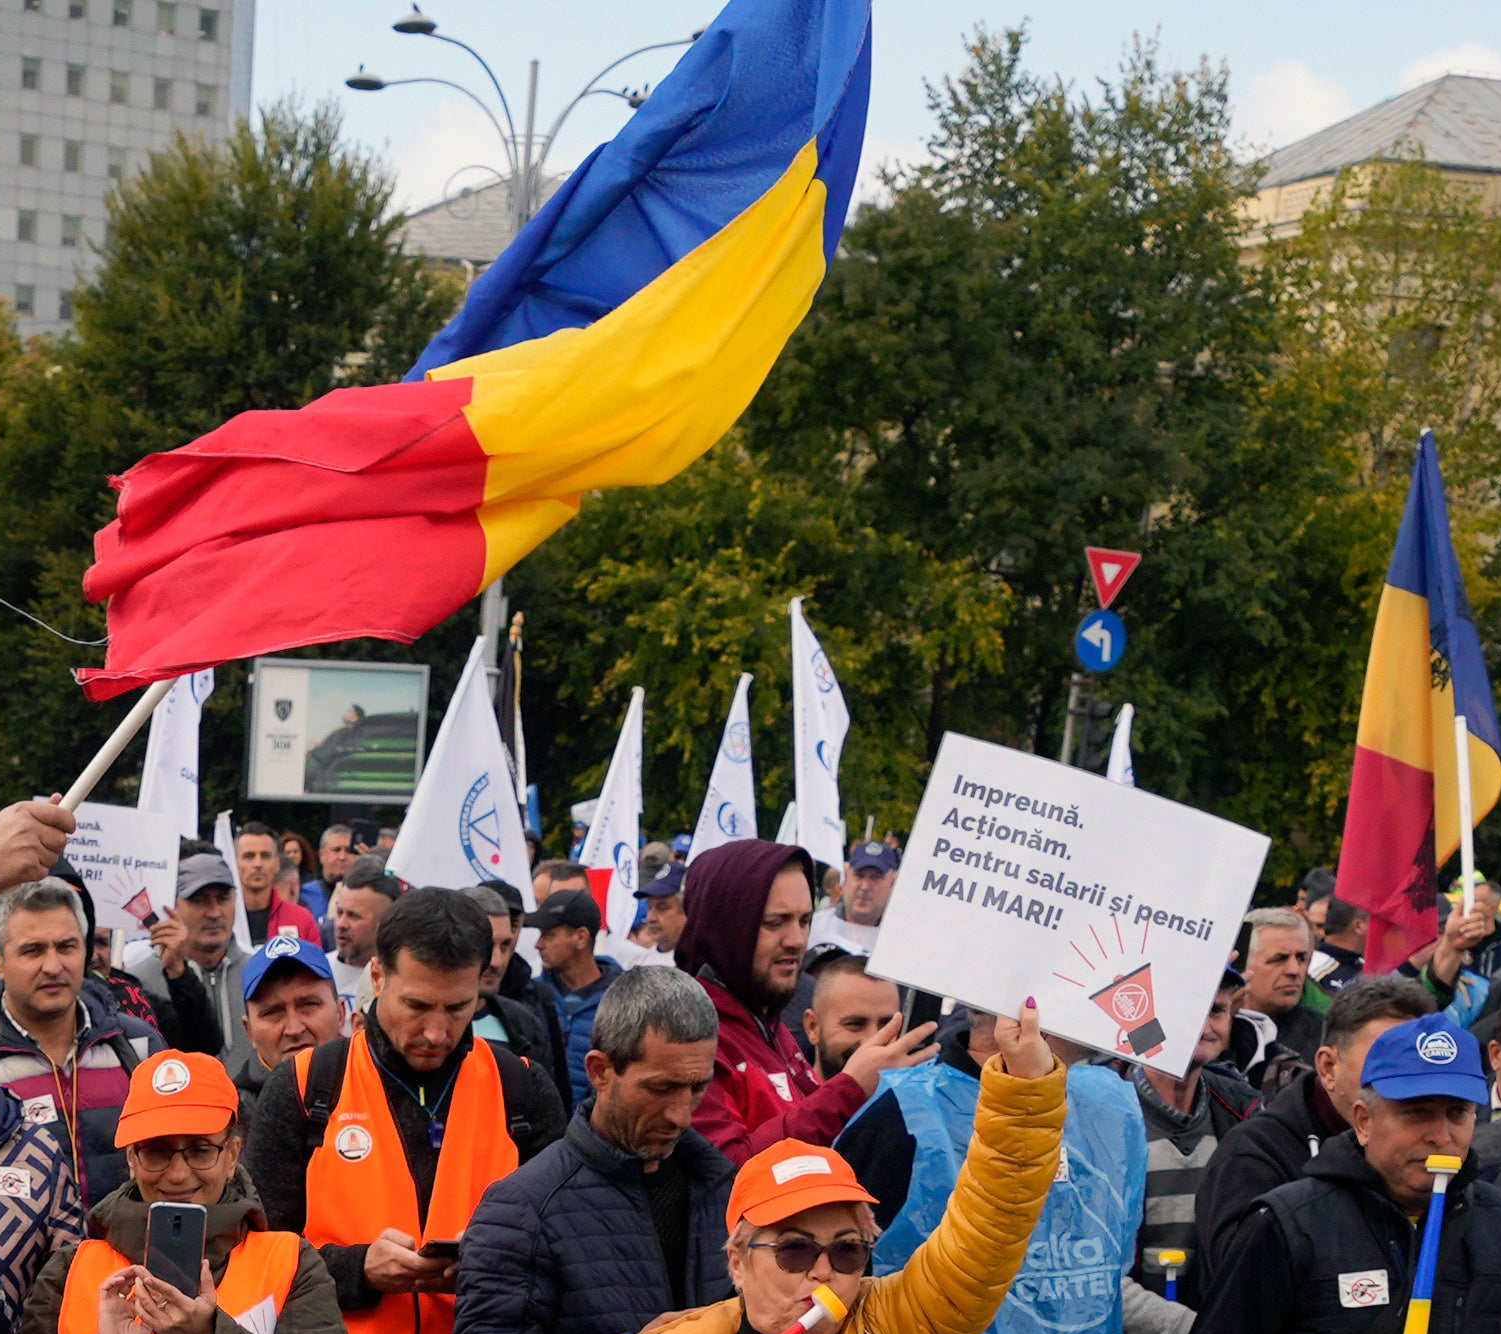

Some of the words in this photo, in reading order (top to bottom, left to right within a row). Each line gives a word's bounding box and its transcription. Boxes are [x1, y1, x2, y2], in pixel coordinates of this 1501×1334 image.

[953, 774, 1084, 830] Impreună.
[941, 807, 1072, 861] Acționăm.
[922, 869, 978, 904] MAI
[982, 885, 1064, 931] MARI!
[932, 838, 1021, 880] Pentru
[1026, 867, 1107, 908] salarii
[1111, 893, 1132, 918] și
[1132, 901, 1215, 942] pensii
